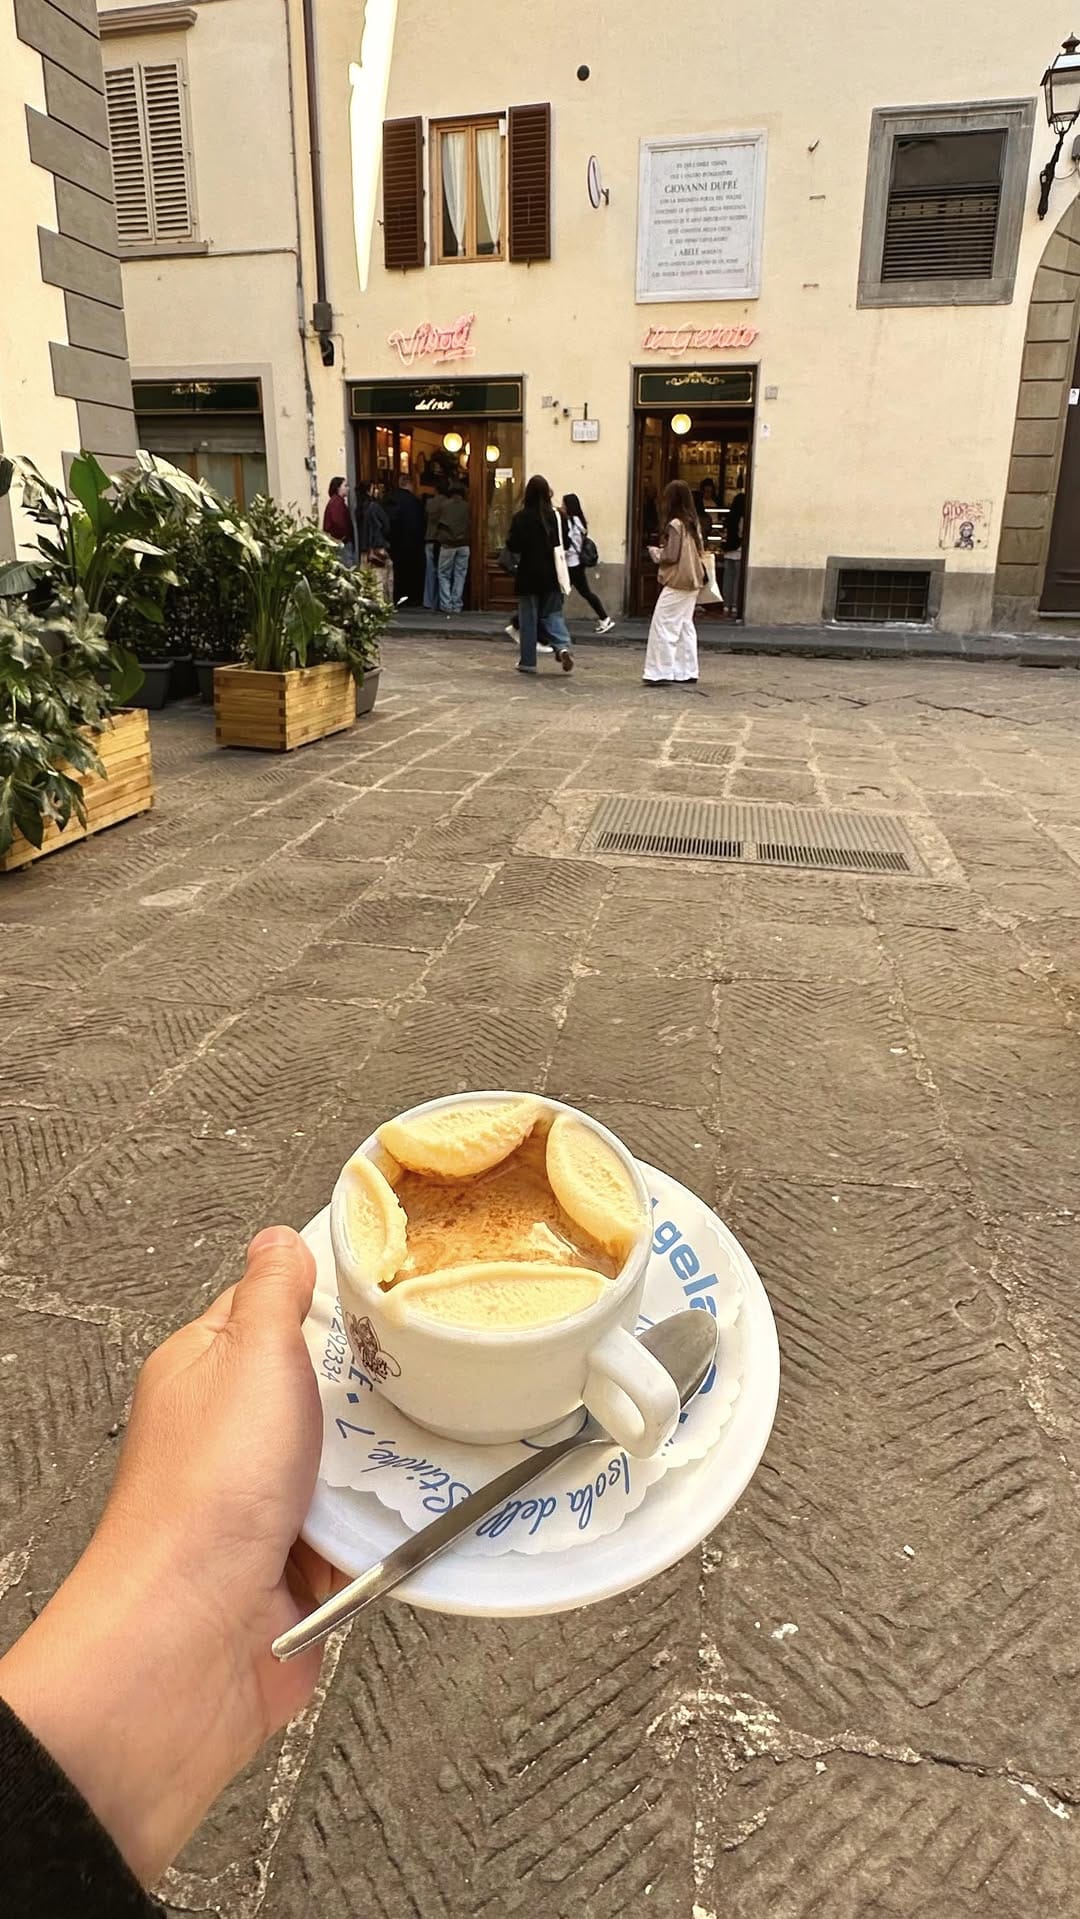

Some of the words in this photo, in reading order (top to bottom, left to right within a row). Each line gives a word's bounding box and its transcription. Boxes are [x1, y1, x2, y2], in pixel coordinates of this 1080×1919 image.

[664, 182, 708, 194] GIOVANNI
[387, 311, 476, 366] Vivoli
[566, 1451, 630, 1530] Isola
[475, 1496, 557, 1538] dell
